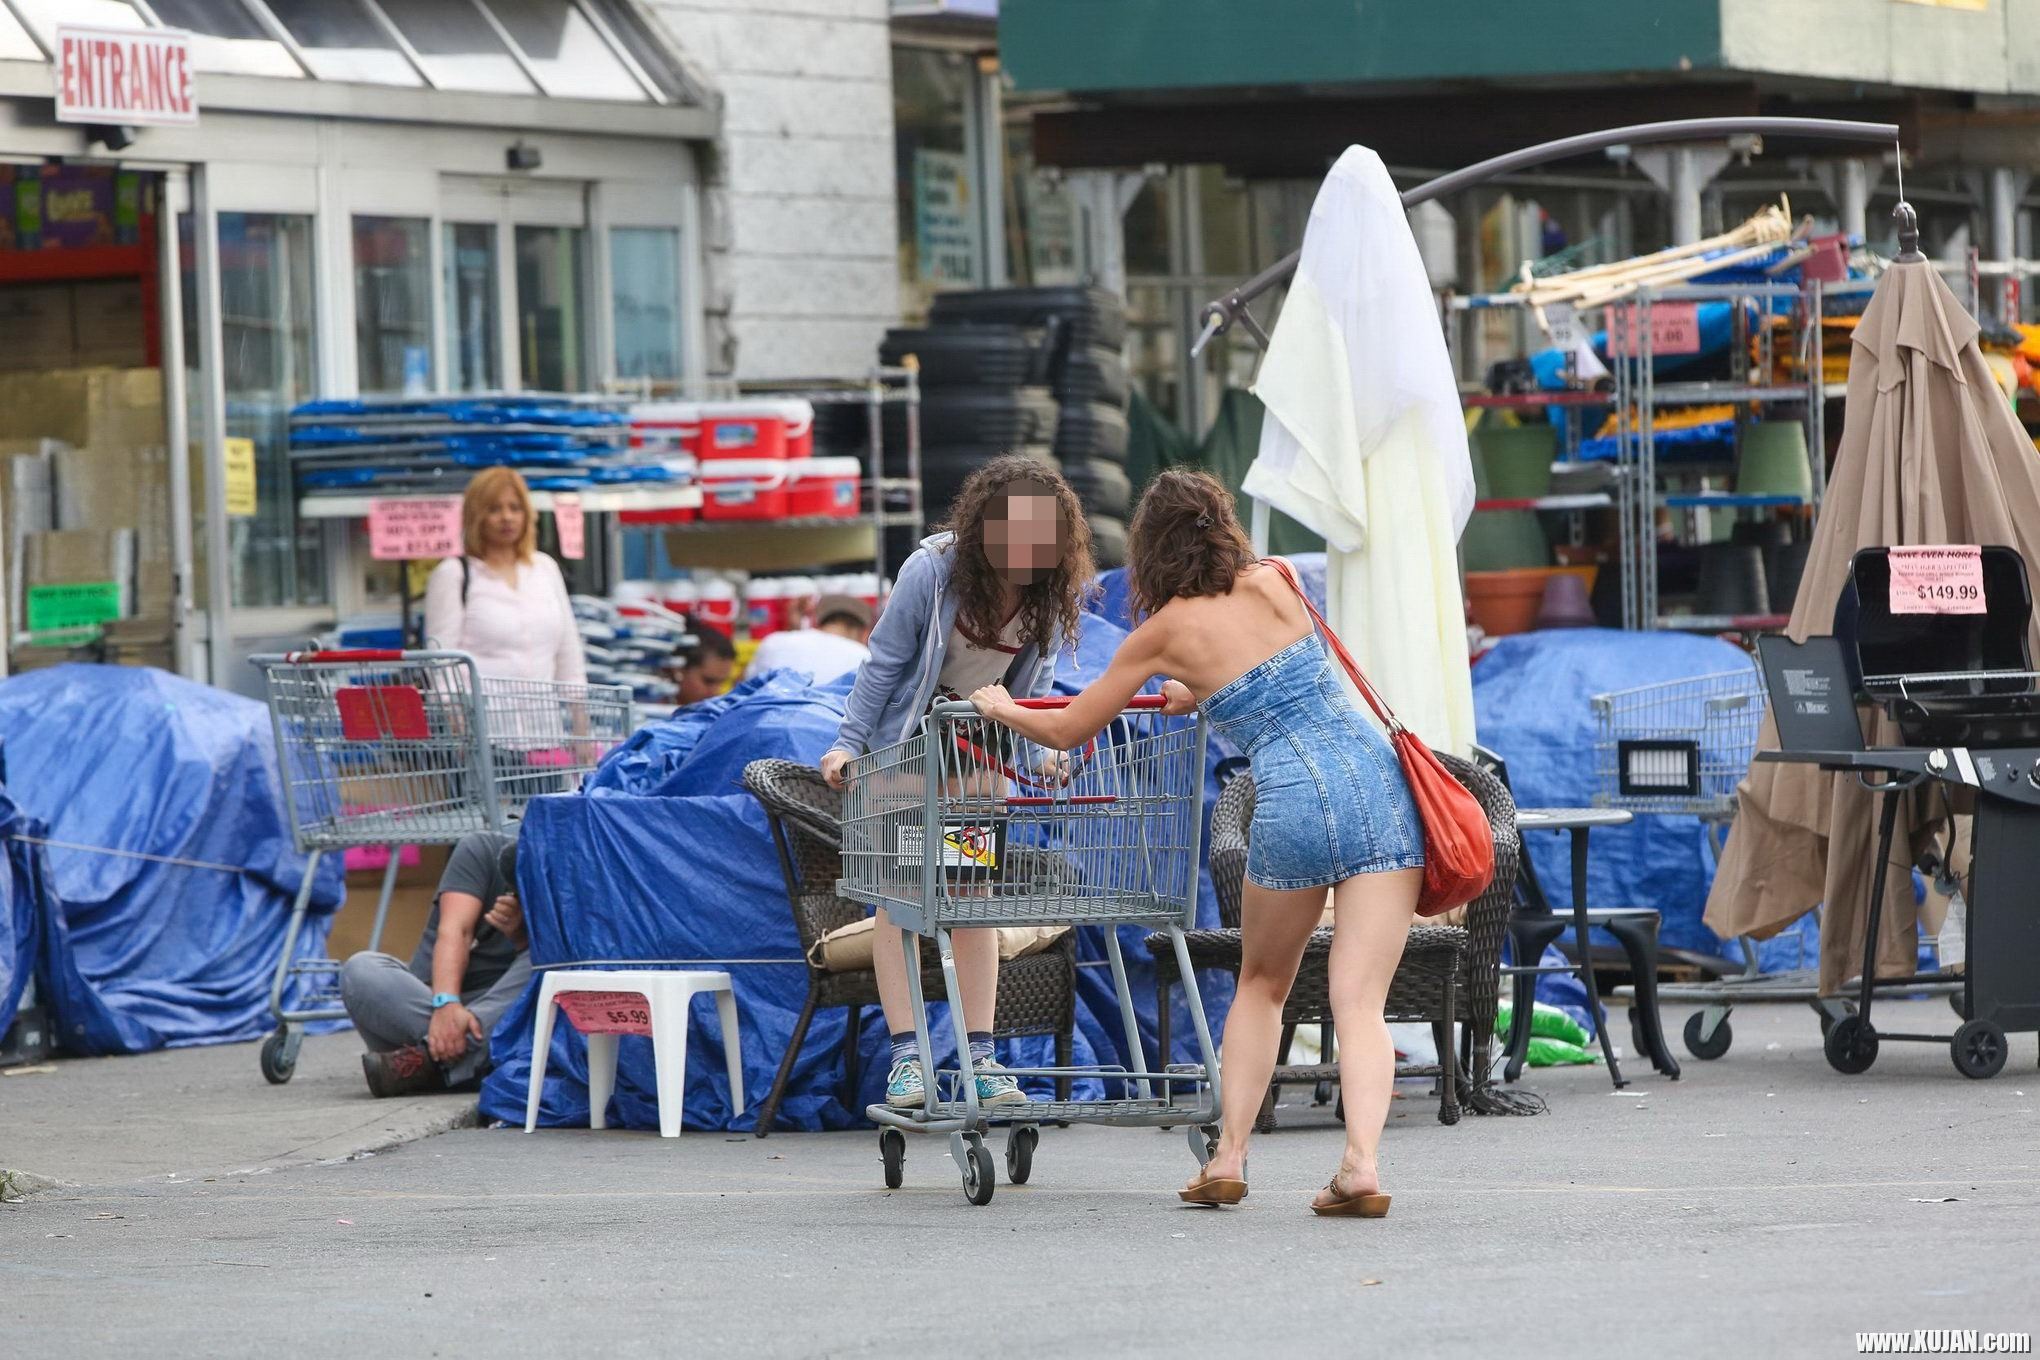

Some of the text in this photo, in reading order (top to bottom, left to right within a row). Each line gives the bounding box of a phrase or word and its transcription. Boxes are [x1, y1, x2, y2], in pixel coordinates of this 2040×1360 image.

[62, 37, 190, 113] ENTRANCE
[1917, 584, 1978, 600] $149.99
[606, 1009, 649, 1025] $5.99
